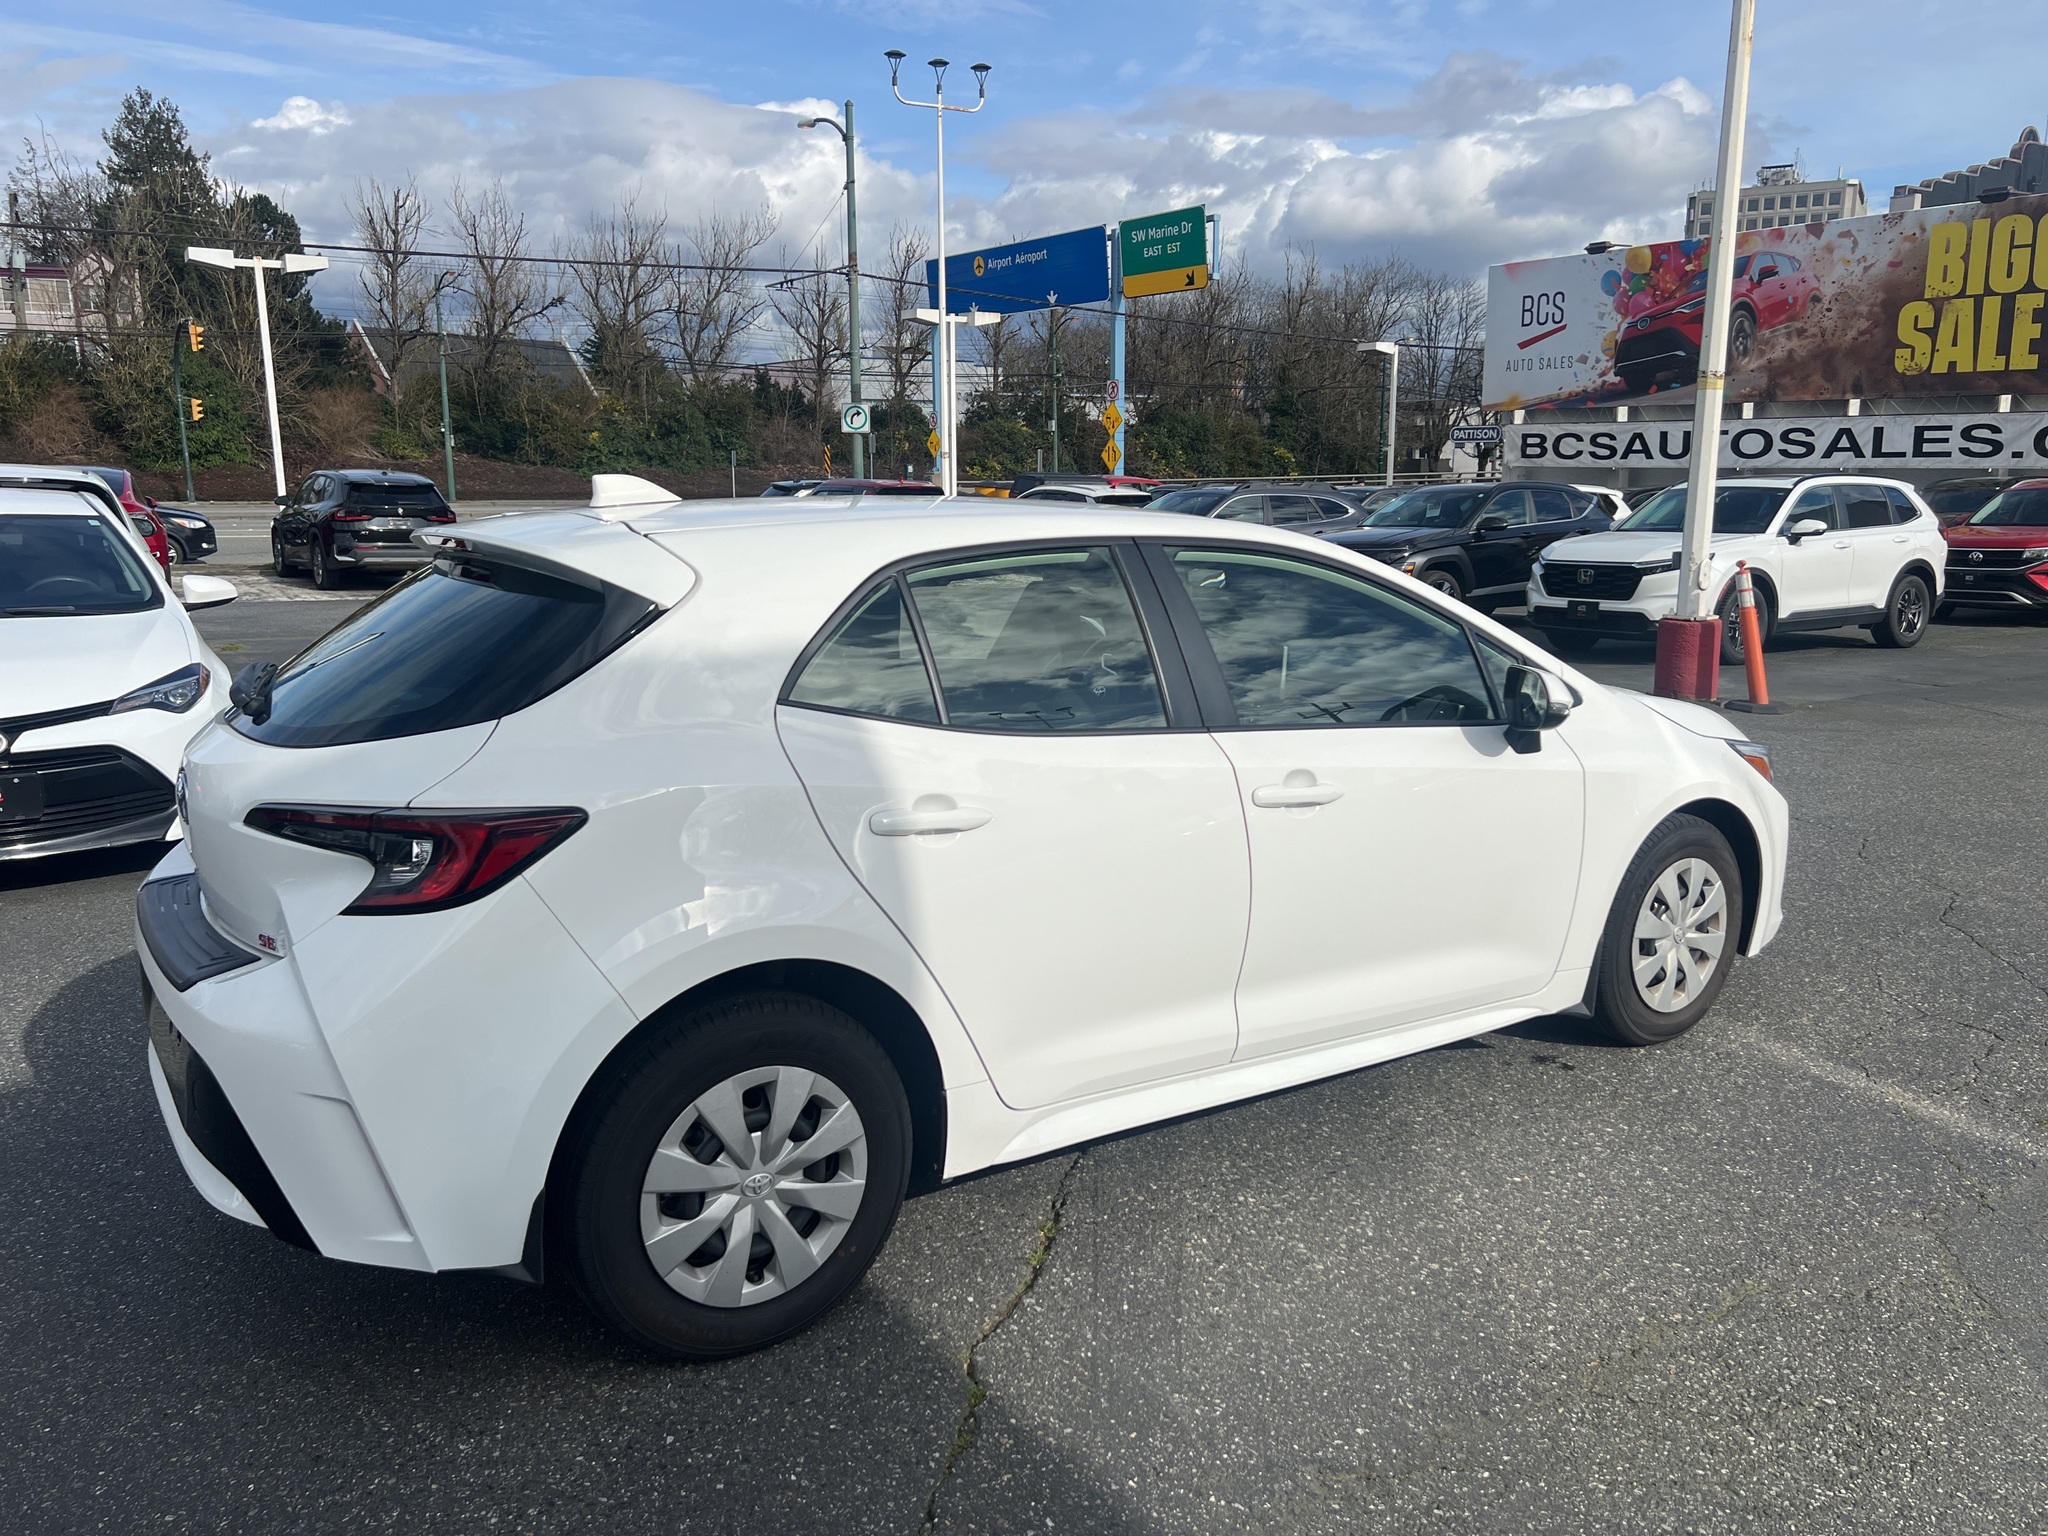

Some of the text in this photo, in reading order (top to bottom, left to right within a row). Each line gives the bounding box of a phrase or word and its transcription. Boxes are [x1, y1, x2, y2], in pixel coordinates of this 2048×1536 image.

[1131, 221, 1193, 243] SW Marine Dr
[987, 249, 1048, 270] Airport Aéroport
[1143, 242, 1181, 257] EAST EST
[1521, 291, 1566, 327] BCS
[1894, 292, 2046, 375] SALE
[1505, 355, 1574, 372] AUTO SALES
[1453, 427, 1498, 440] PATTISON
[1521, 423, 2048, 460] BCSAUOSALES.
[258, 933, 276, 951] SE
